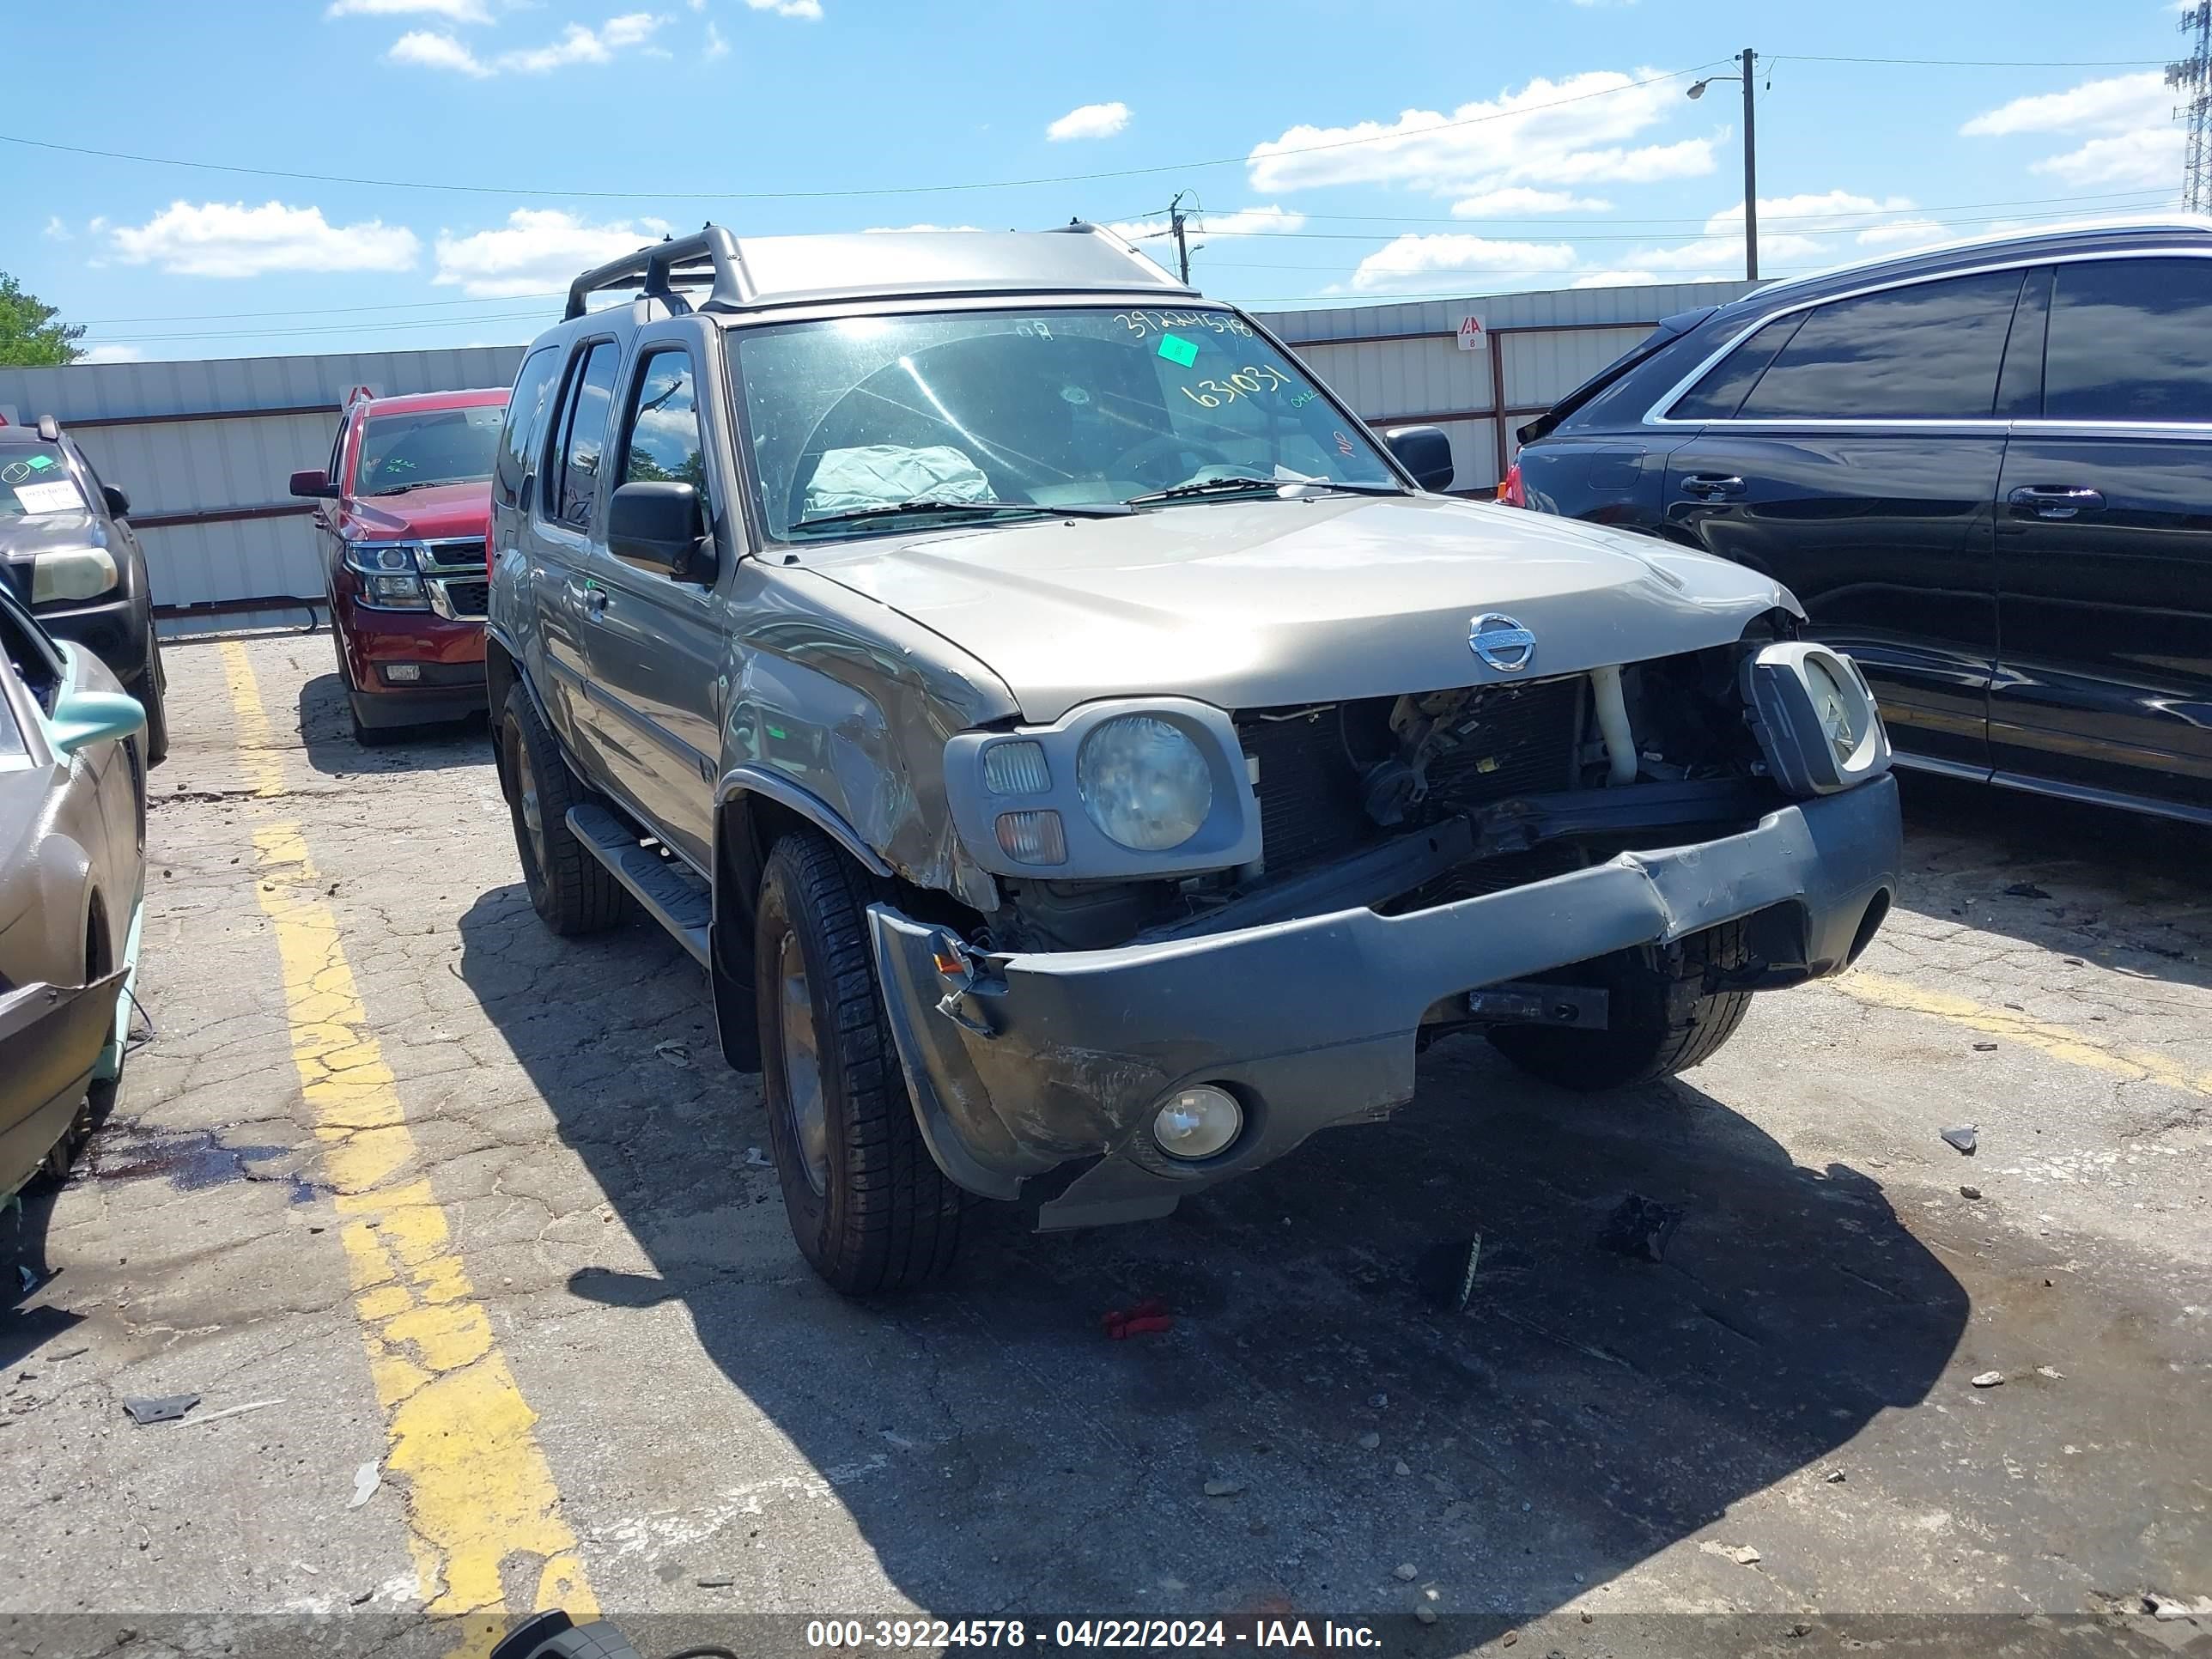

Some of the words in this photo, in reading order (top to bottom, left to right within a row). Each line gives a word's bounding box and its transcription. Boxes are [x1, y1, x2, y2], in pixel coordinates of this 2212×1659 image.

[1113, 310, 1254, 338] 39224578
[1469, 338, 1476, 348] 8
[1181, 364, 1292, 408] 631031
